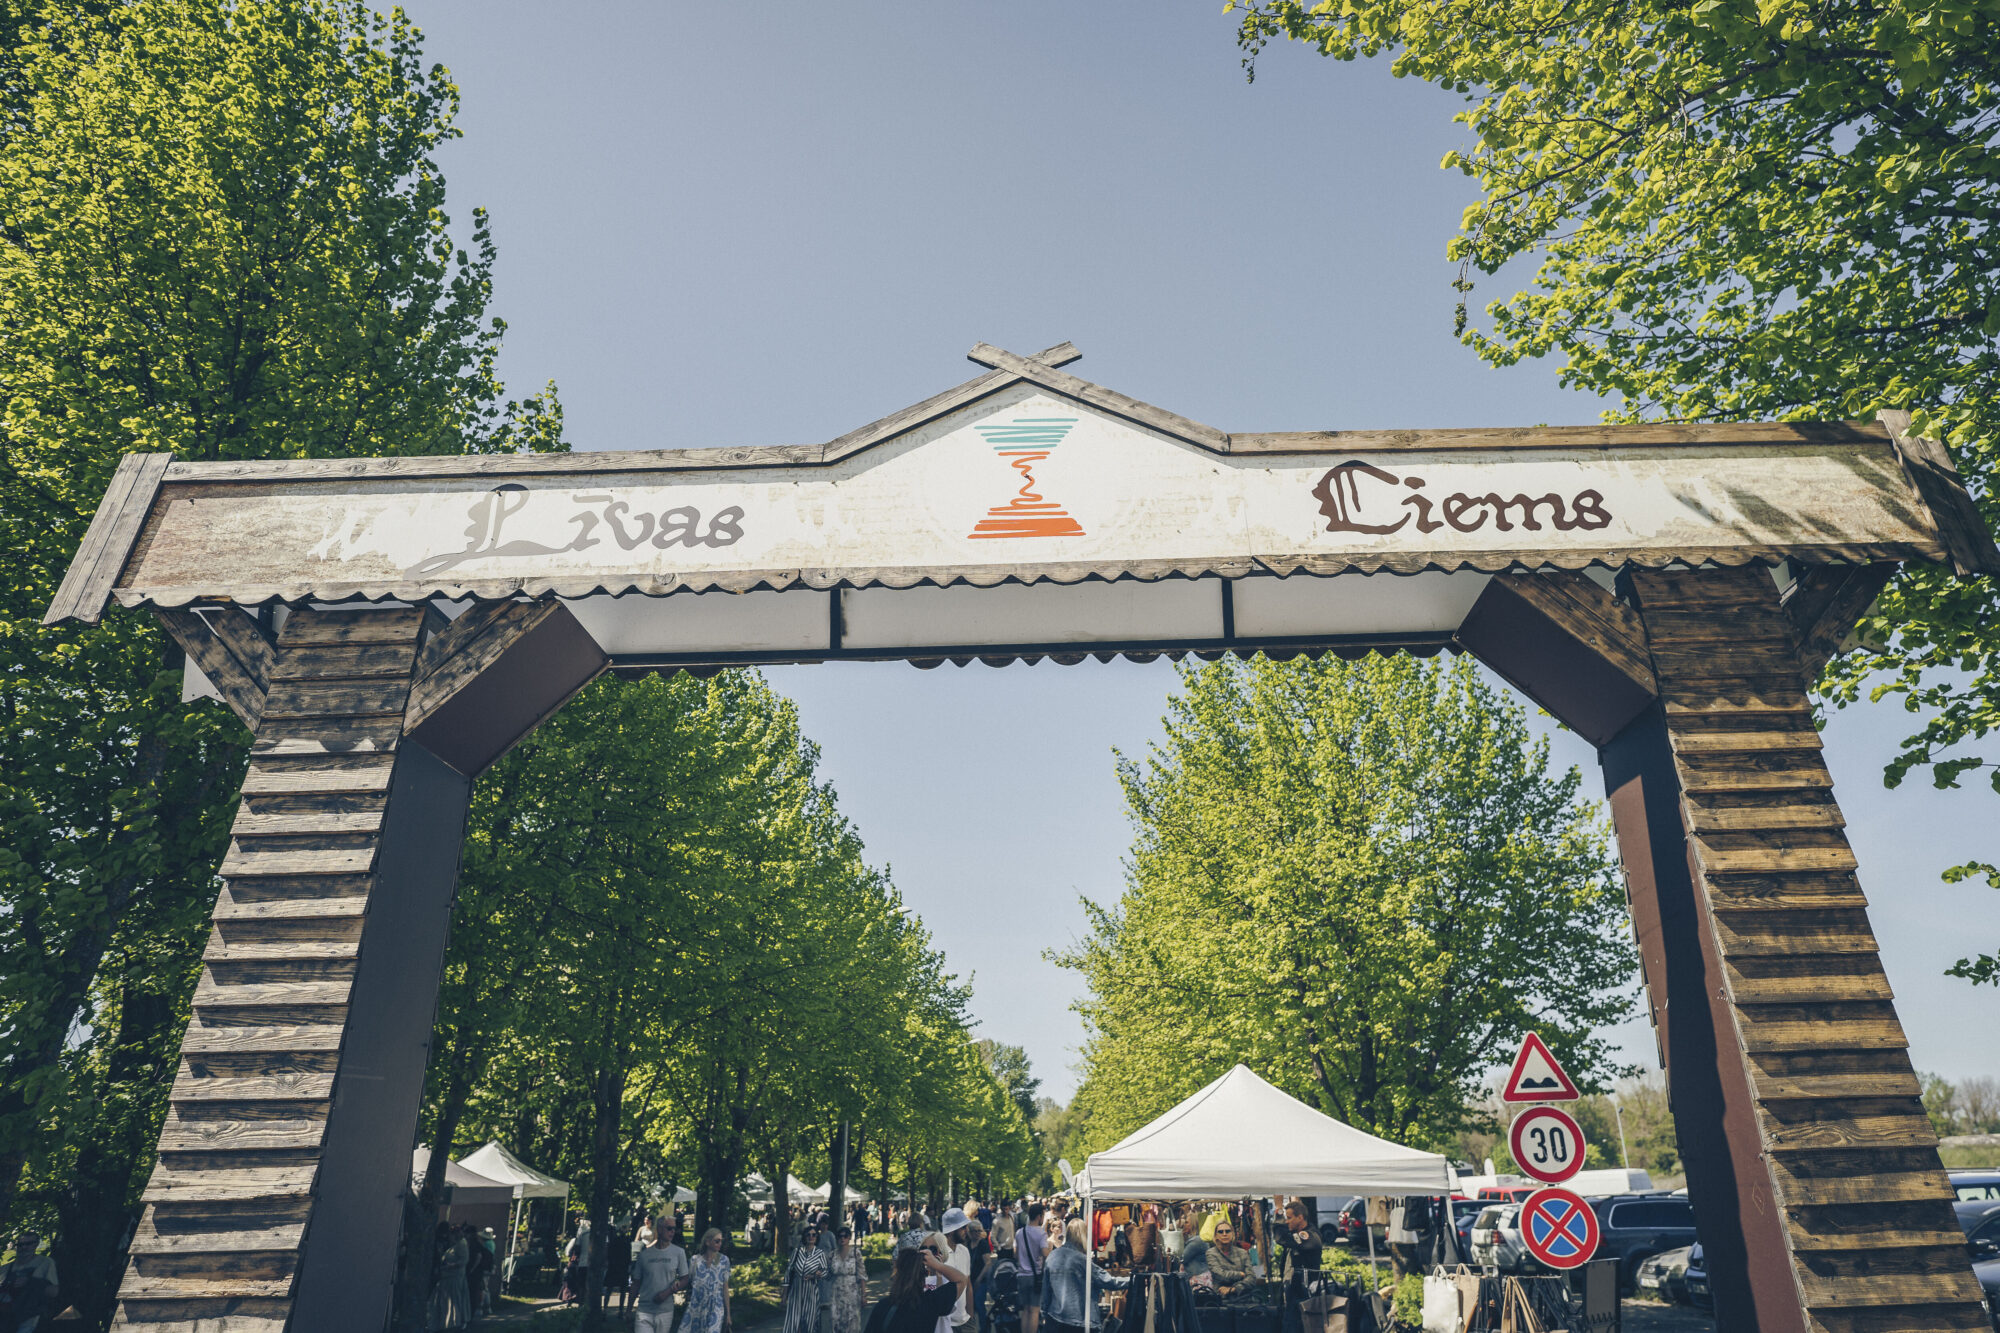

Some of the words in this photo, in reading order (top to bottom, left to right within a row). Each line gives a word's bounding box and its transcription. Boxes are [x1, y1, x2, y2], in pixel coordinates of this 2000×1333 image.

[403, 483, 745, 581] Līvas
[1312, 460, 1613, 535] Ciems
[1530, 1127, 1567, 1164] 30
